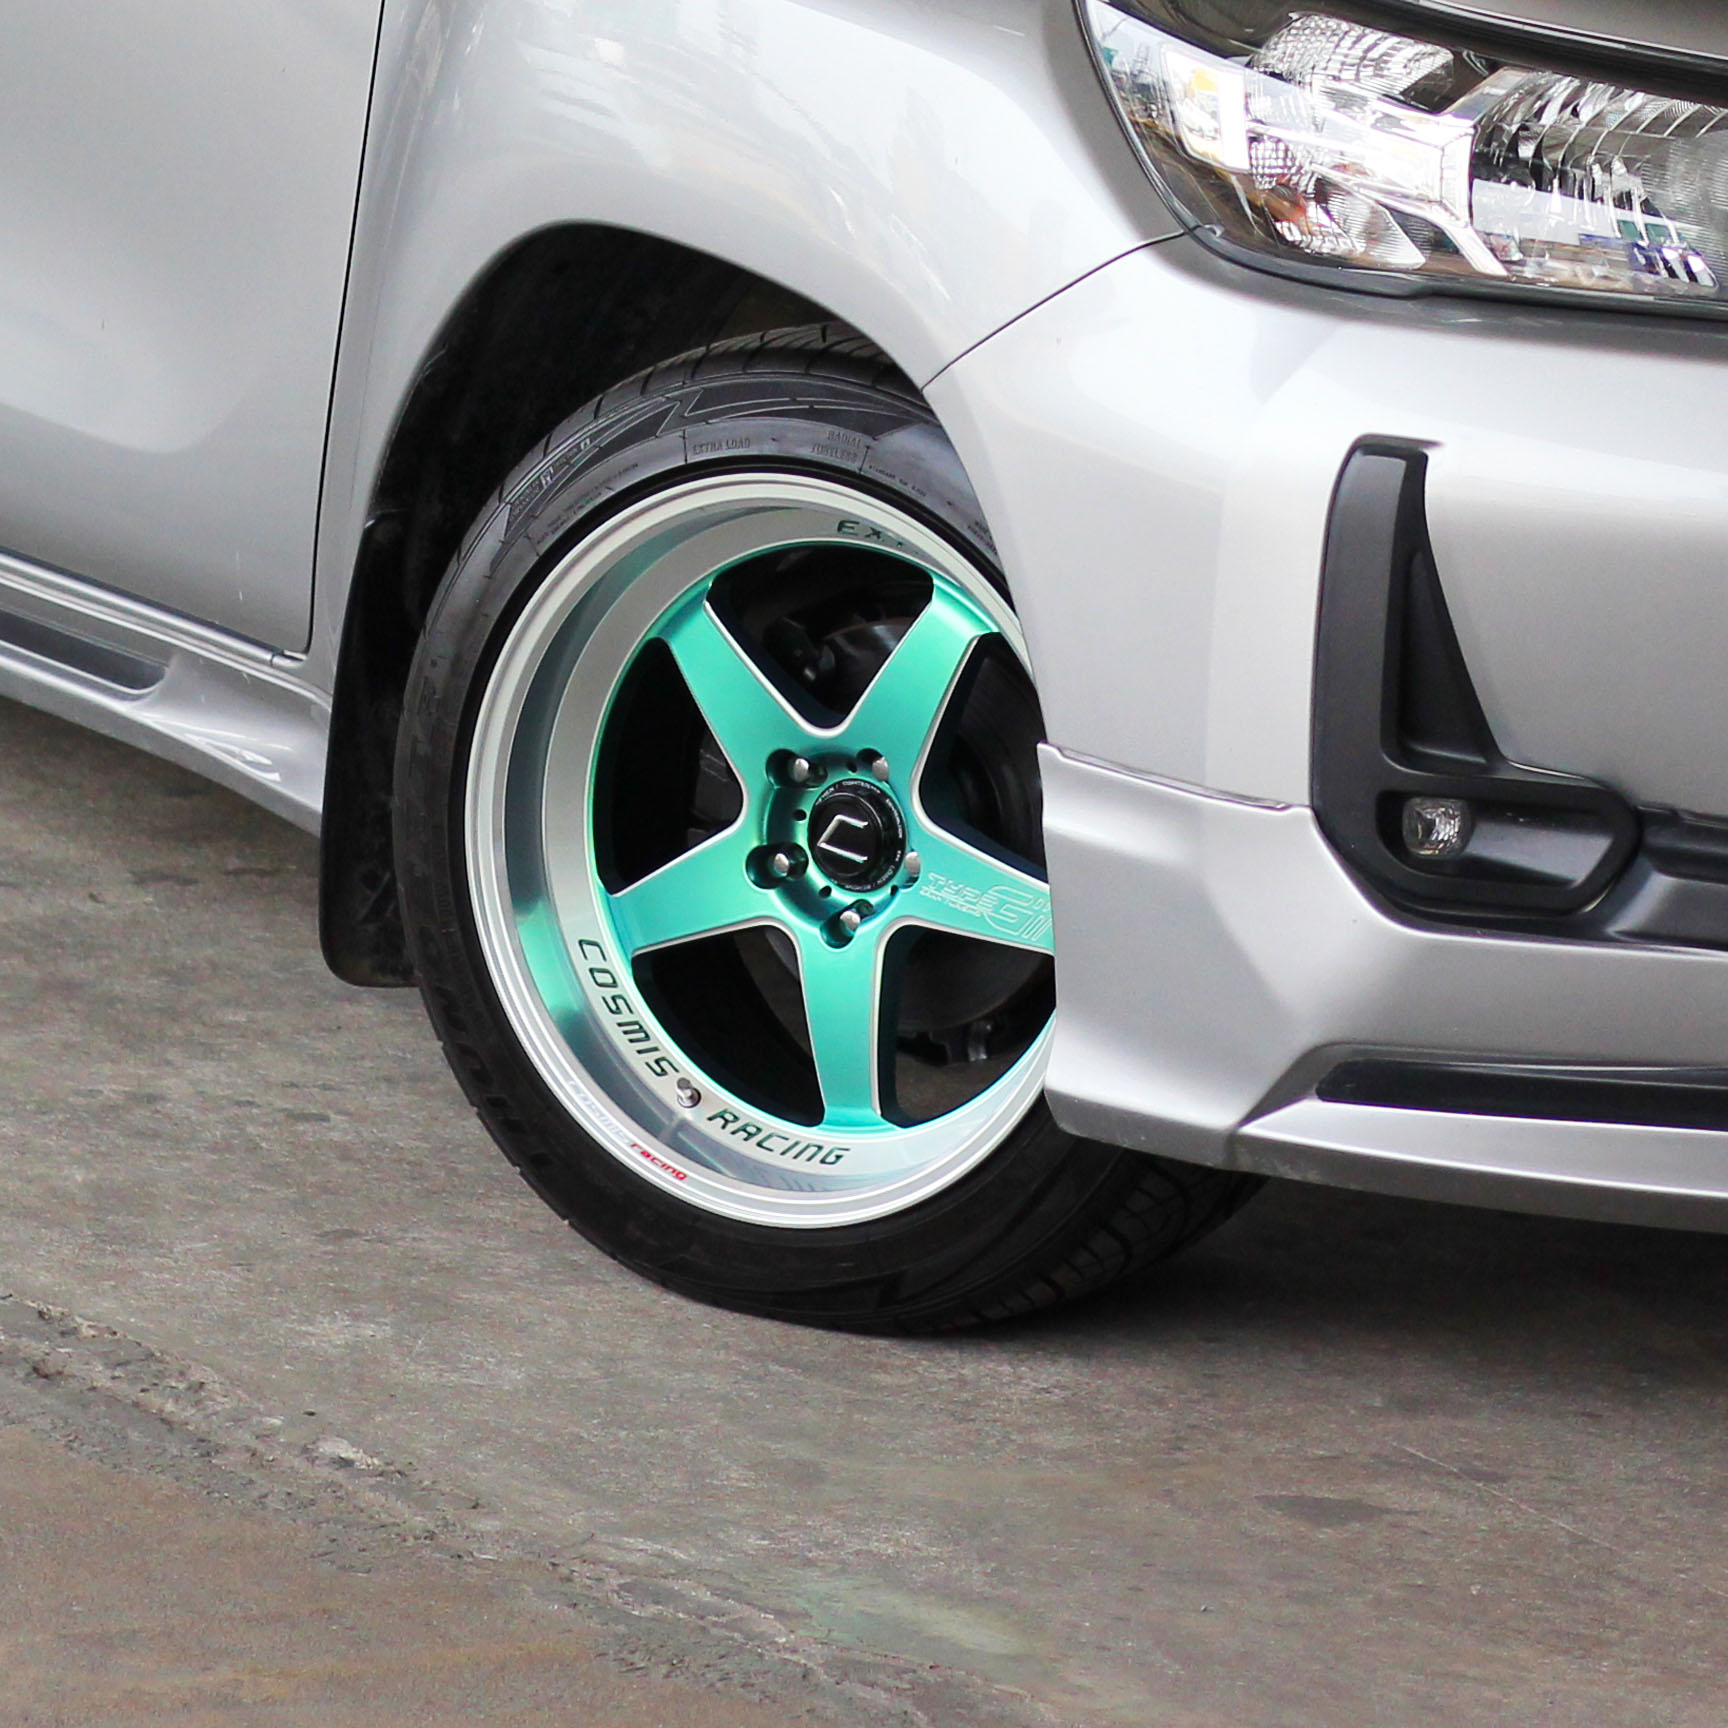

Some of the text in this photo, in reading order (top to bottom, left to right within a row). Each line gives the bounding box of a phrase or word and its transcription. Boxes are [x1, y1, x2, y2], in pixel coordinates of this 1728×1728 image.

[691, 437, 752, 456] EXTRA LOAD
[577, 937, 852, 1167] COSMIS RACING
